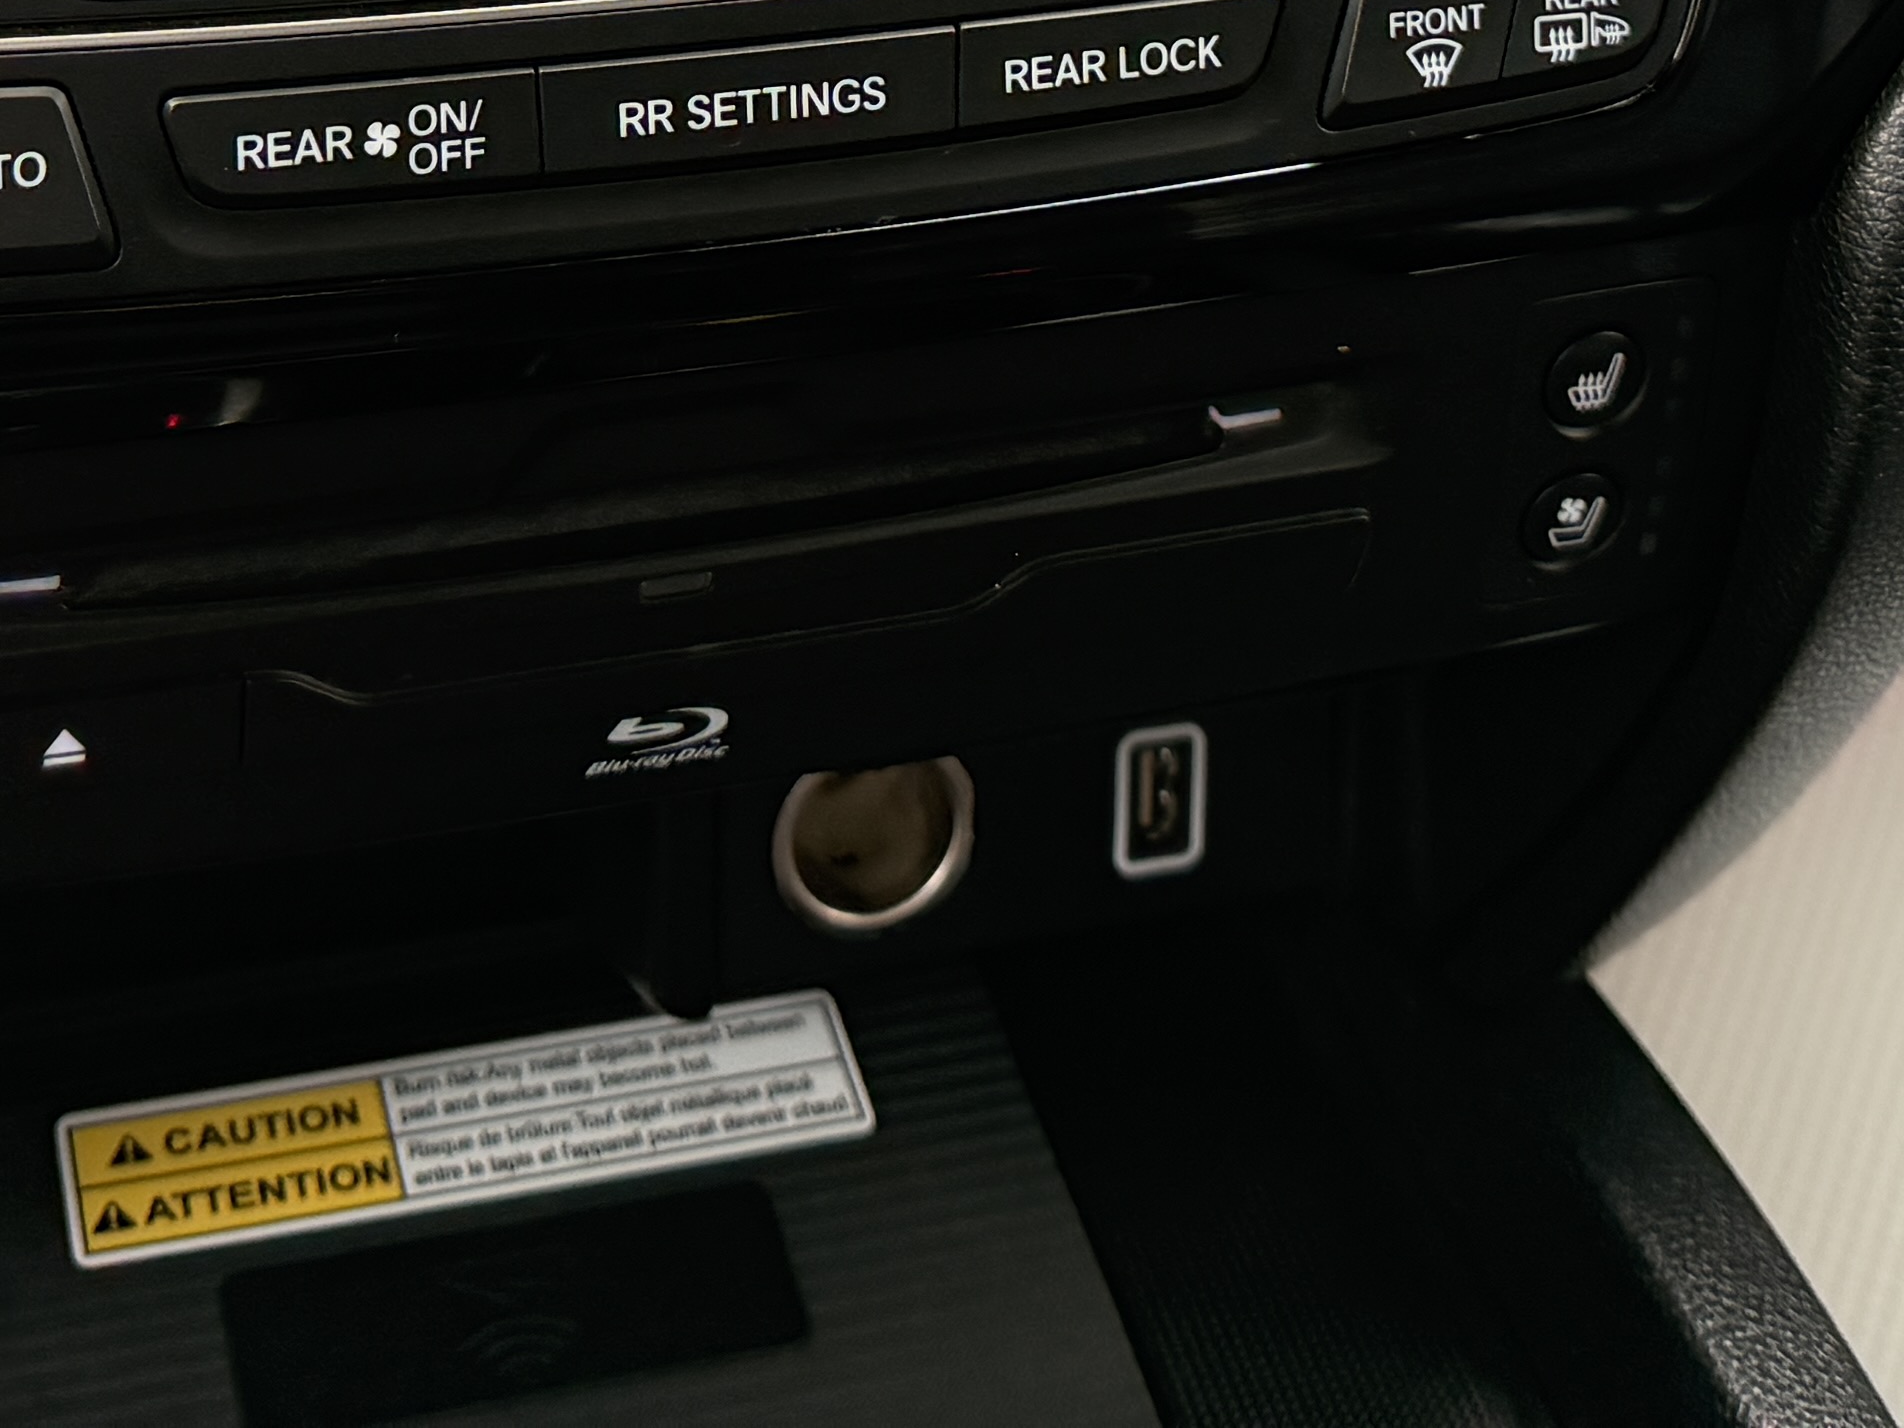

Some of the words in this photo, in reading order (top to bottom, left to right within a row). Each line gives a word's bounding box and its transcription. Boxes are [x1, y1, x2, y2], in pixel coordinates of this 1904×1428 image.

[1388, 1, 1485, 38] FRONT
[1003, 50, 1107, 94] REAR
[1118, 33, 1223, 79] LOCK
[407, 98, 484, 137] ON/
[617, 96, 673, 139] RR
[685, 75, 888, 131] SETTINGS
[235, 125, 354, 172] REAR
[408, 136, 487, 176] OFF
[164, 1097, 360, 1155] CAUTION
[146, 1157, 393, 1226] ATTENTION
